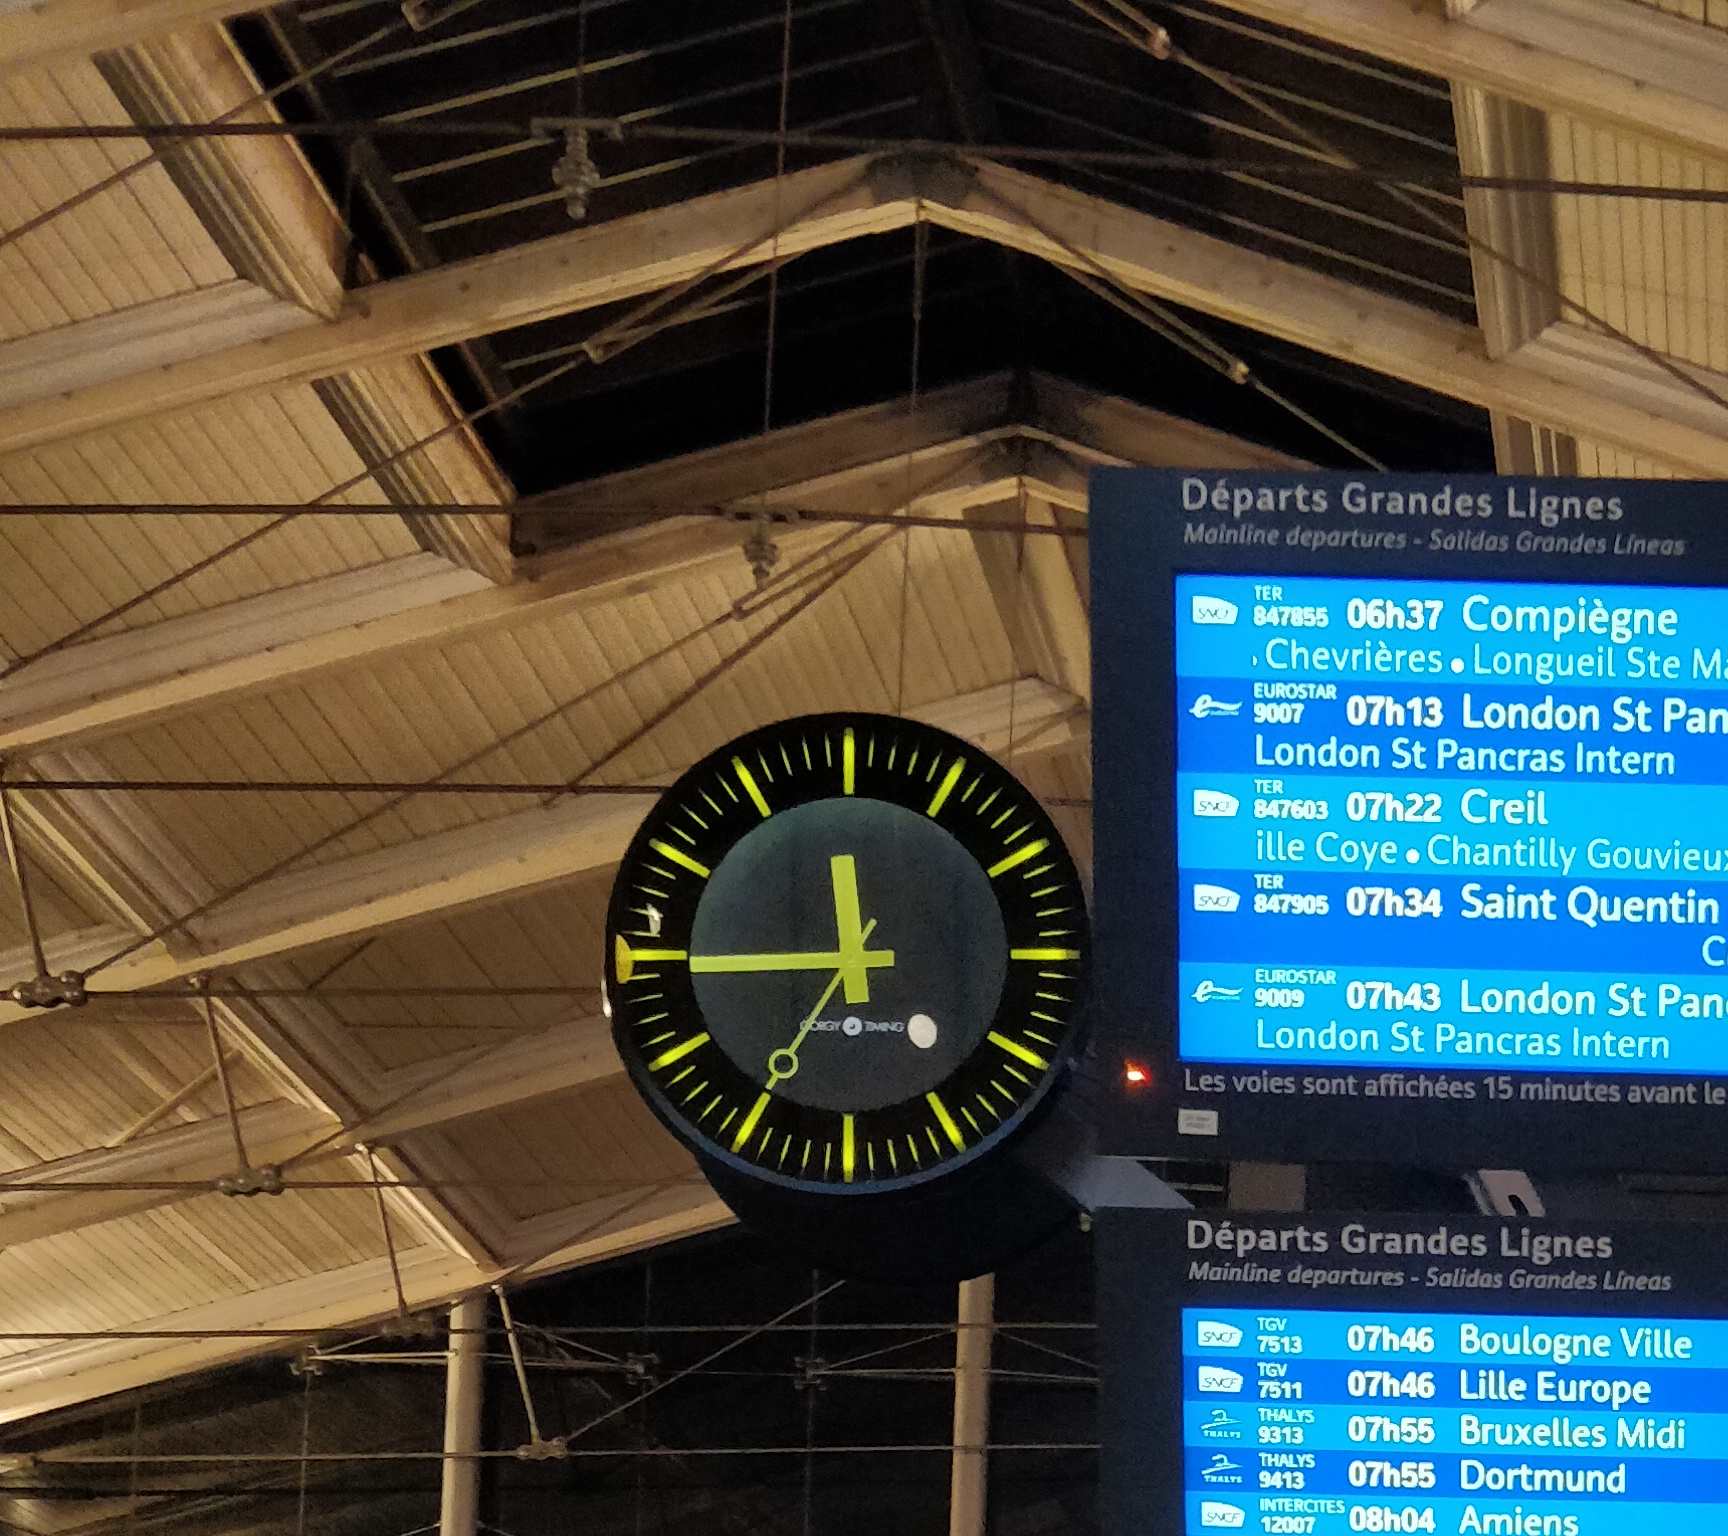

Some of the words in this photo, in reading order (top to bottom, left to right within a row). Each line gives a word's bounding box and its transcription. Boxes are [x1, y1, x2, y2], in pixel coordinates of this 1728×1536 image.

[1182, 479, 1328, 519] Départs
[1342, 482, 1492, 517] Grandes
[1508, 488, 1623, 526] Lignes
[1184, 524, 1278, 547] Mainline
[1286, 527, 1406, 551] departures
[1430, 529, 1508, 552] Salidas
[1517, 532, 1606, 554] Grandes
[1255, 585, 1282, 601] TER
[1254, 606, 1328, 627] 847855
[1347, 599, 1443, 631] 06h37
[1463, 594, 1678, 643] Compiègne
[1254, 684, 1337, 700] EUROSTAR
[1254, 704, 1304, 724] 9007
[1346, 696, 1443, 728] 07h13
[1463, 695, 1599, 731] London
[1612, 696, 1652, 734] St
[1347, 792, 1441, 822] 07h22
[1461, 789, 1547, 825] Creil
[1346, 886, 1443, 917] 07h34
[1461, 884, 1557, 920] Saint
[1568, 886, 1719, 927] Quentin
[1347, 981, 1441, 1011] 07h43
[1461, 979, 1595, 1015] London
[1608, 982, 1647, 1017] St
[1185, 1070, 1225, 1094] Les
[1232, 1071, 1295, 1095] voies
[1303, 1076, 1357, 1096] sont
[1366, 1075, 1474, 1100] affichées
[1483, 1077, 1512, 1099] 15
[1520, 1078, 1620, 1103] minutes
[1628, 1083, 1696, 1106] avant
[1705, 1082, 1727, 1106] le
[1188, 1220, 1328, 1257] Départs
[1340, 1225, 1487, 1257] Grandes
[1501, 1229, 1613, 1265] Lignes
[1347, 1325, 1435, 1354] 07h46
[1460, 1324, 1610, 1365] Boulogne
[1620, 1327, 1693, 1360] Ville
[1348, 1371, 1436, 1399] 07h46
[1460, 1370, 1527, 1401] Lille
[1536, 1372, 1652, 1410] Europe
[1348, 1417, 1436, 1445] 07h55
[1460, 1415, 1606, 1448] Bruxelles
[1616, 1419, 1686, 1450] Midi
[1348, 1461, 1436, 1490] 07h55
[1460, 1460, 1626, 1494] Dortmund
[1349, 1506, 1436, 1533] 08h04
